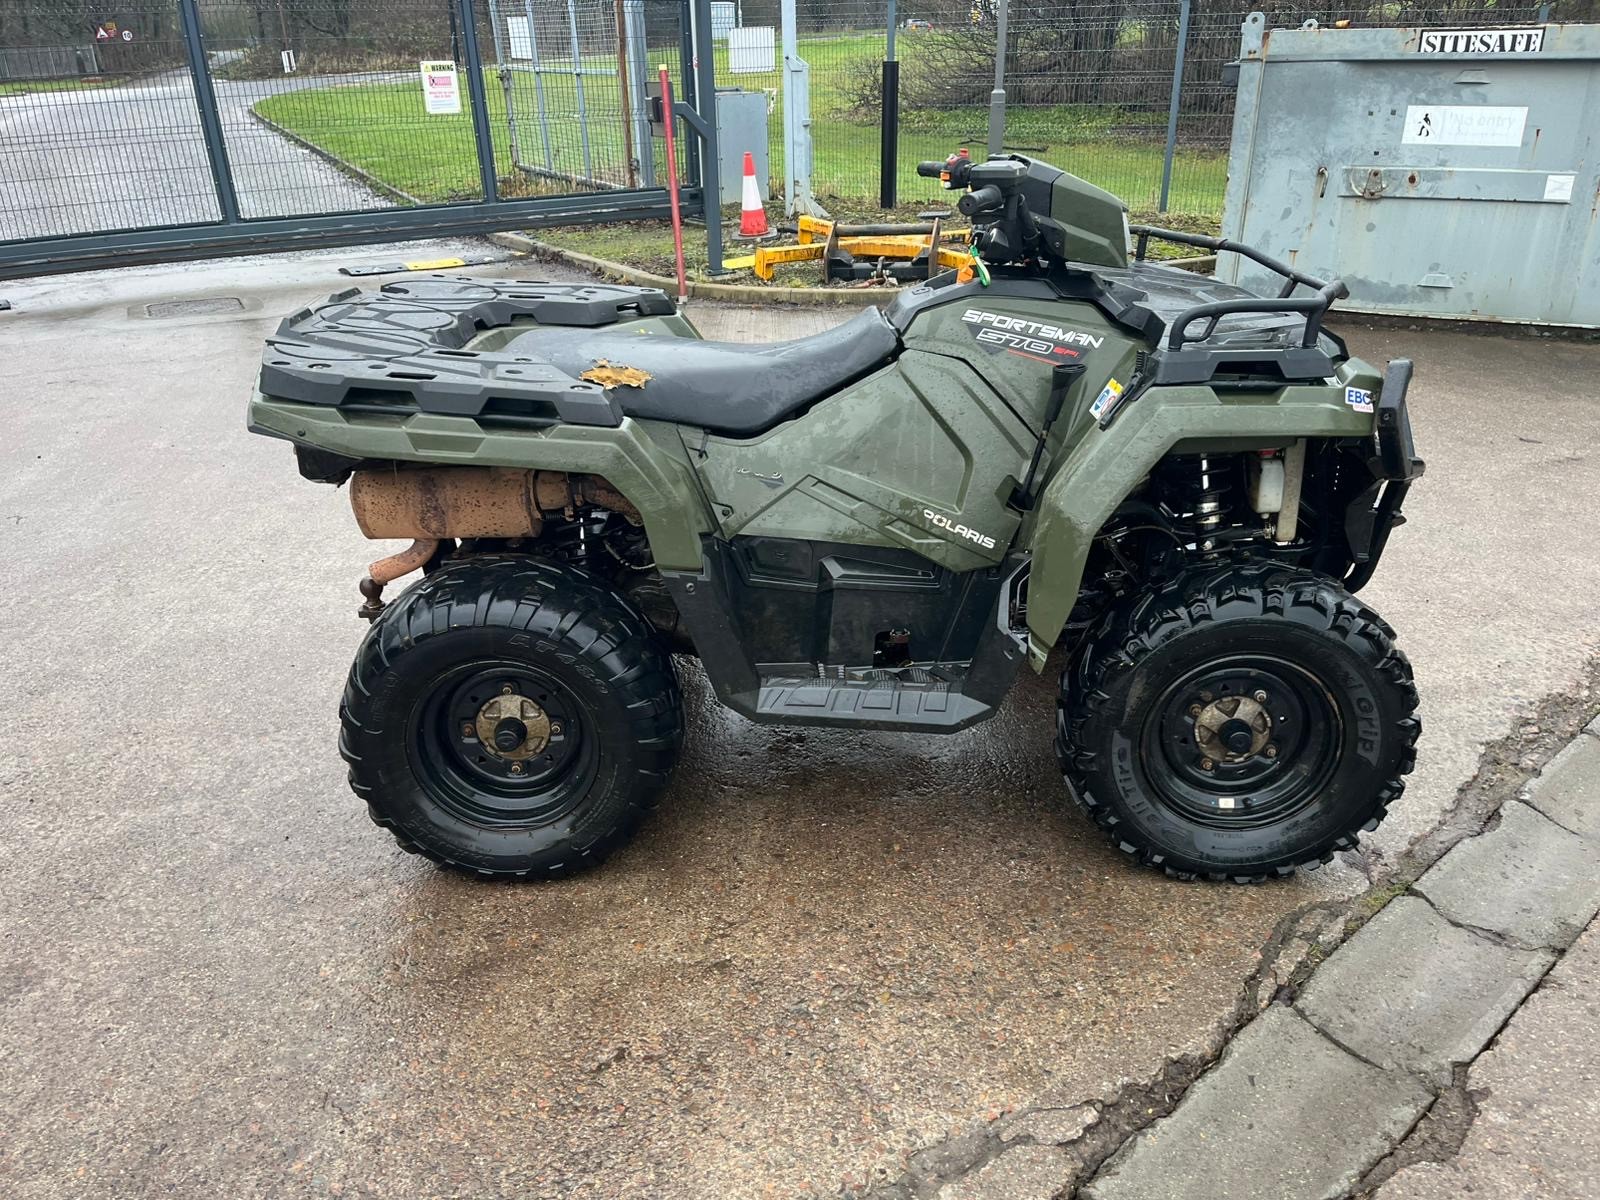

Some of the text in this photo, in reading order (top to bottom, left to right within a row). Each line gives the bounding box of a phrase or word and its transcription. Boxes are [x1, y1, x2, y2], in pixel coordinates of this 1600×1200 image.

[1423, 33, 1539, 53] SITESAFE
[961, 309, 1104, 349] SPORTSMAN
[976, 328, 1054, 354] 570
[923, 509, 996, 549] POLARIS
